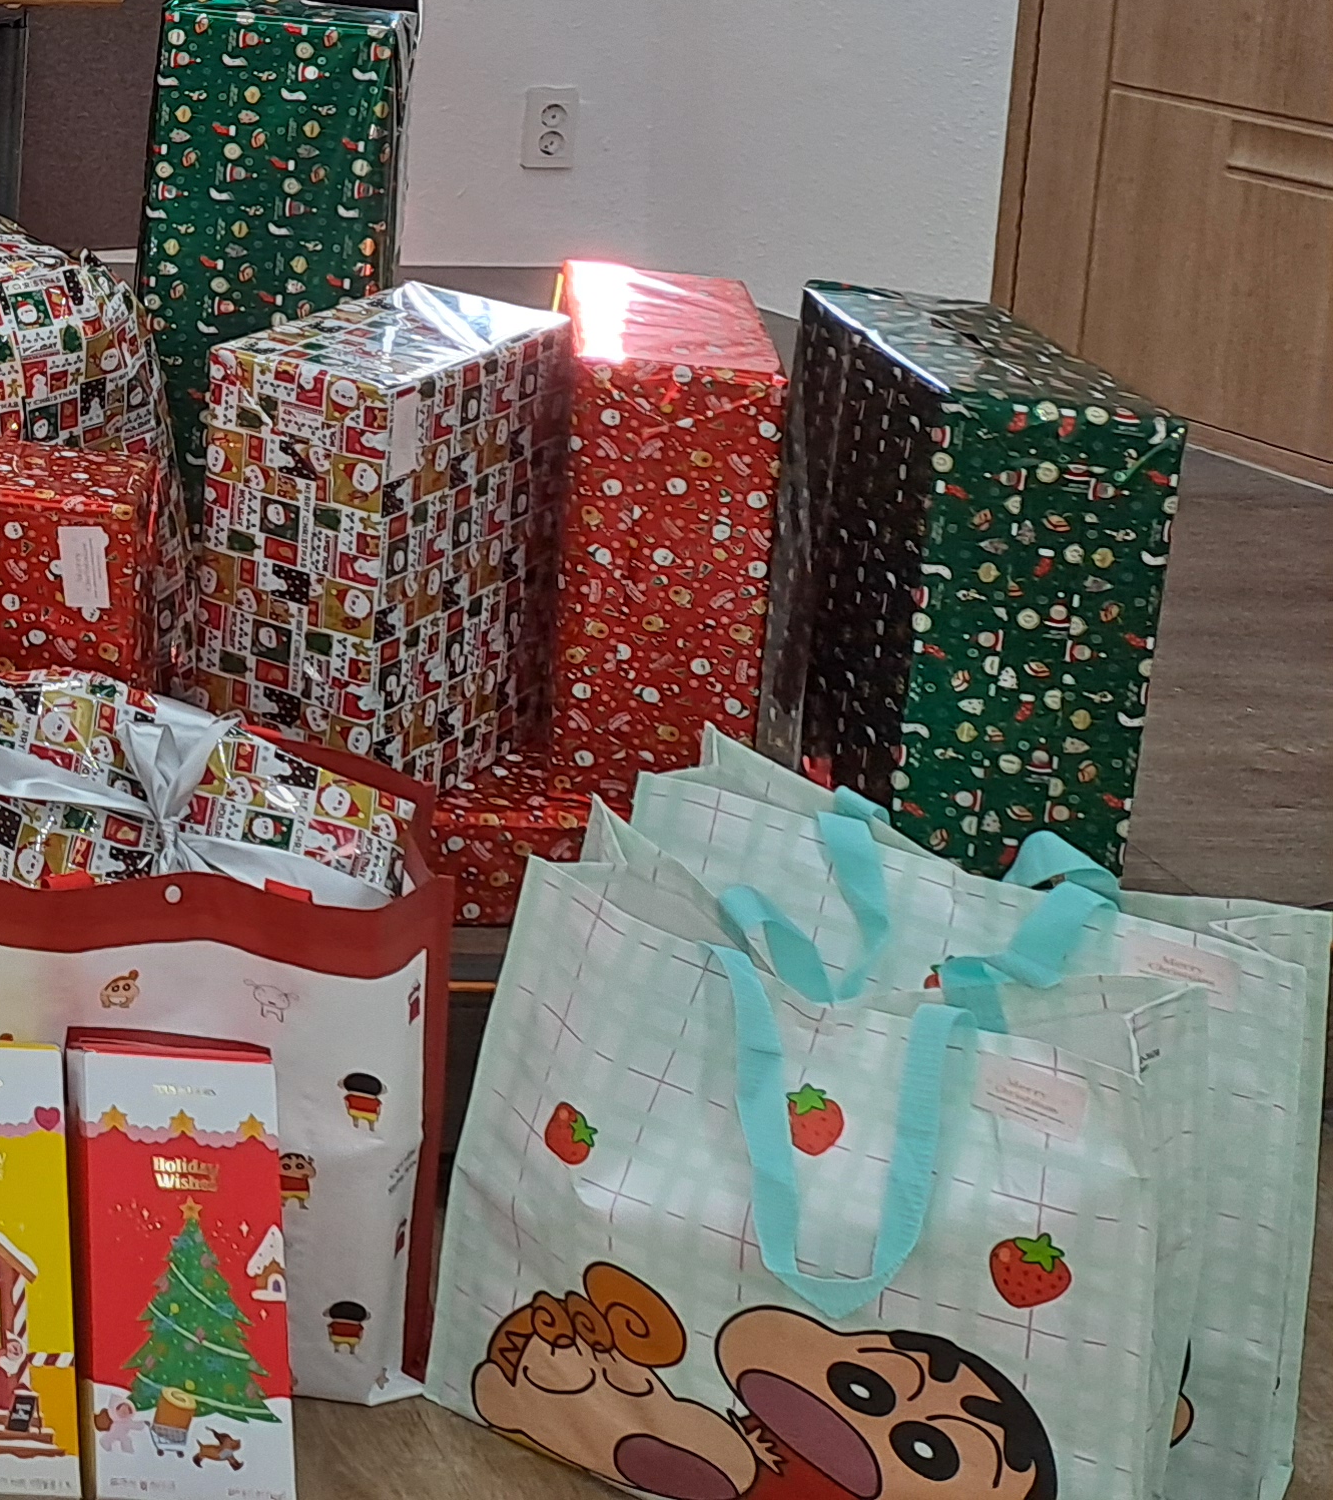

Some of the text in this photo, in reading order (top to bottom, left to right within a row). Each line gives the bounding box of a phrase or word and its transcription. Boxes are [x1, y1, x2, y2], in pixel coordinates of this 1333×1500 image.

[214, 803, 226, 837] HOLIDA
[152, 1155, 220, 1176] Holiday
[154, 1172, 218, 1192] Wishes
